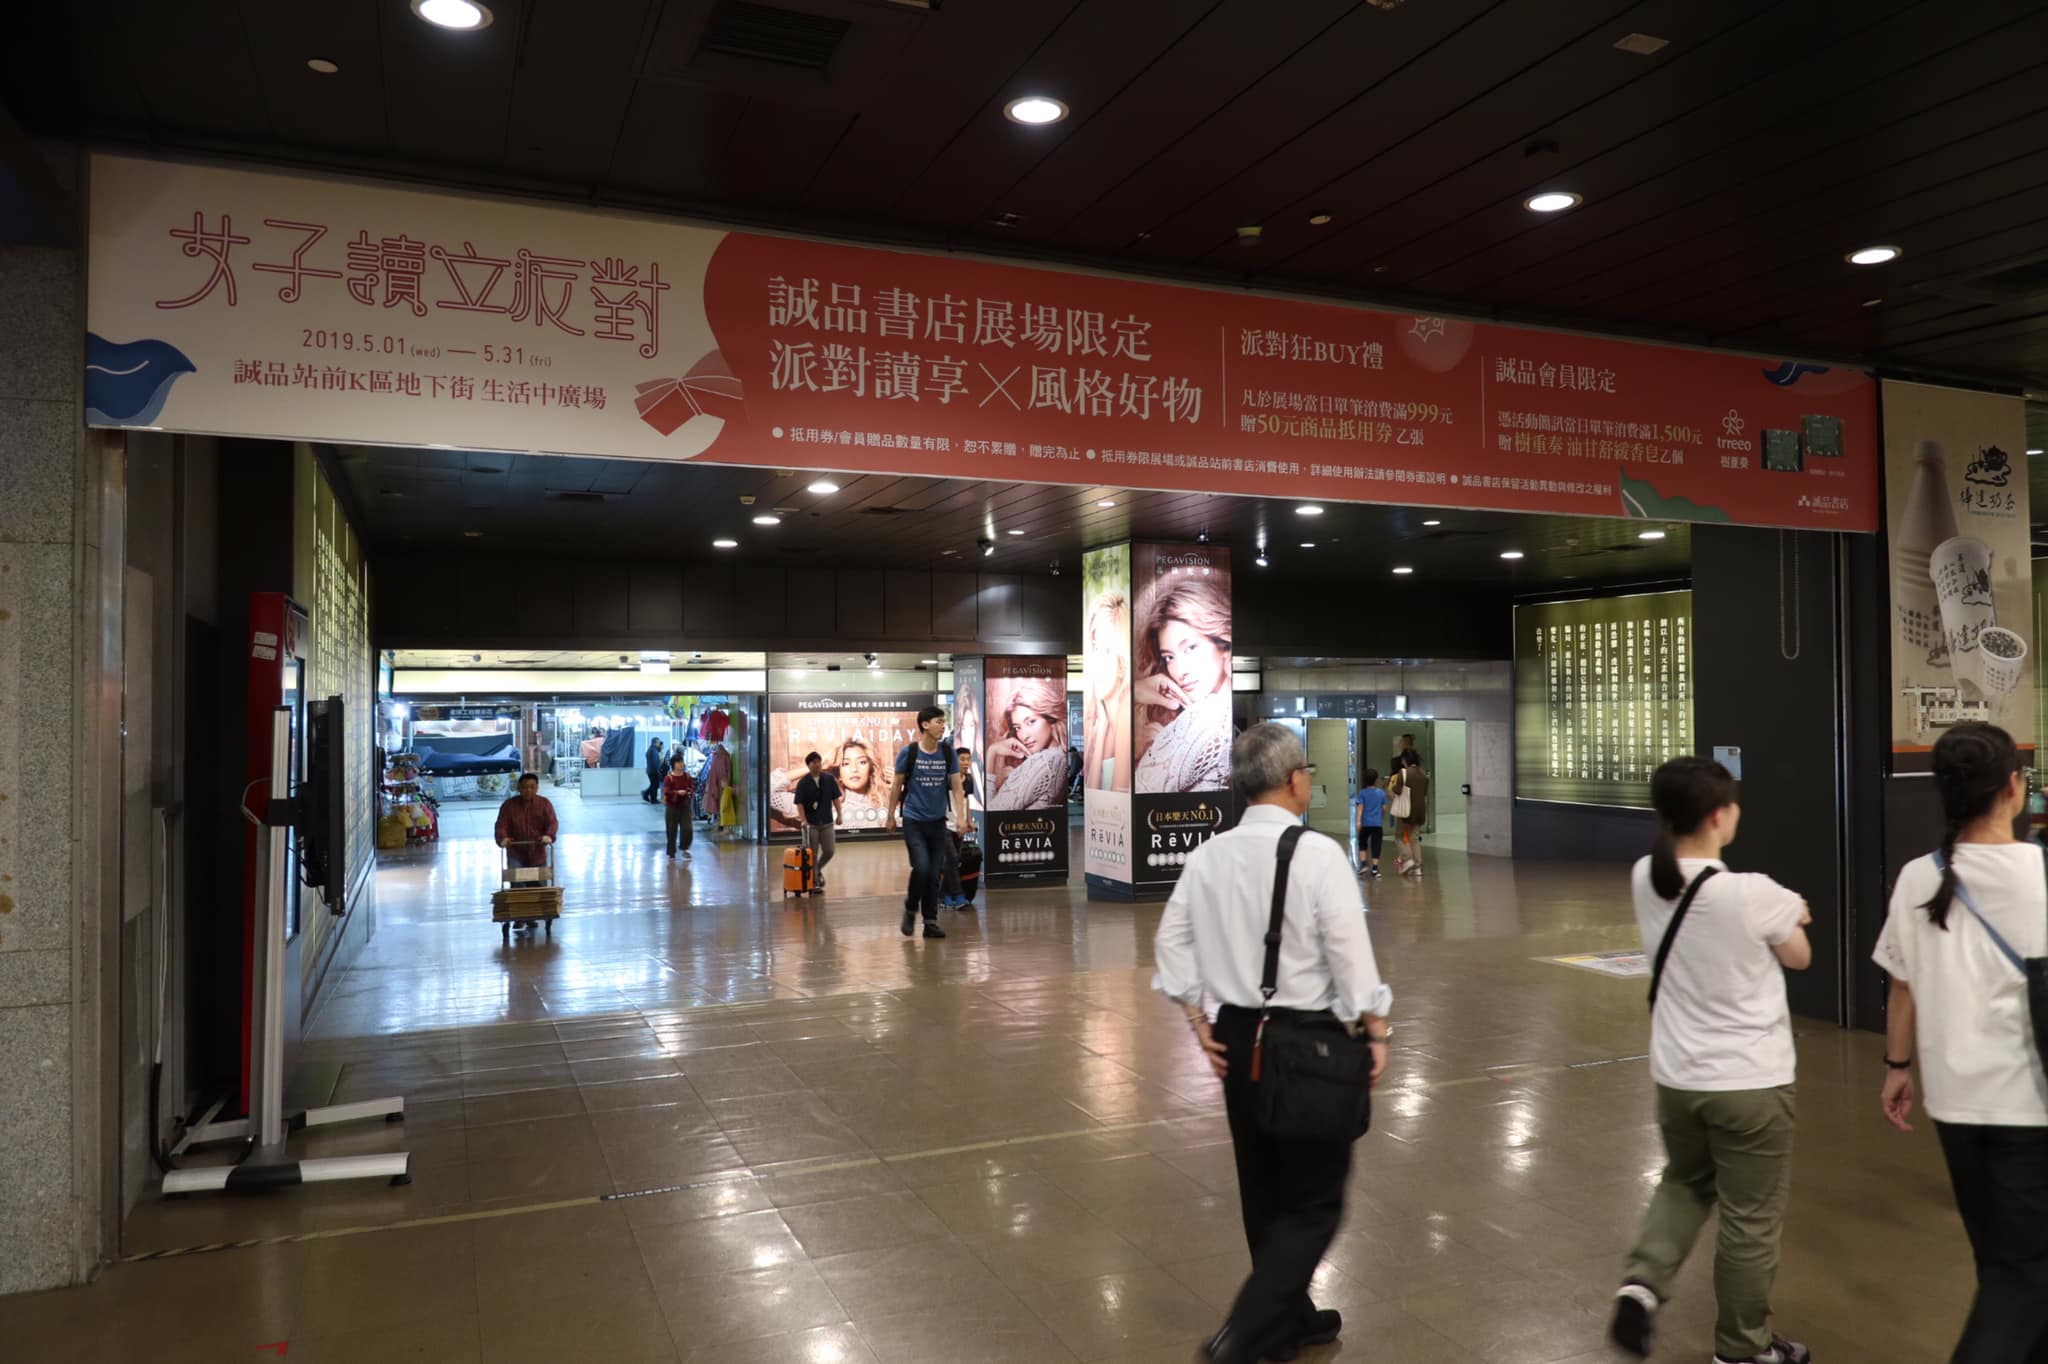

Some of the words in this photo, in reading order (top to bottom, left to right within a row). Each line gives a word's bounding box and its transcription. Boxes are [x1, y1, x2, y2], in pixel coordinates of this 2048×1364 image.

[767, 275, 1153, 362] 誠品書店展場限定
[302, 329, 405, 356] 2019.5.01
[483, 345, 524, 365] 5.31
[1241, 327, 1384, 370] 派對狂BUY禮
[1495, 356, 1618, 394] 誠品會員限定
[481, 378, 608, 410] 生活中廣場
[1155, 552, 1210, 570] PEGAVISION
